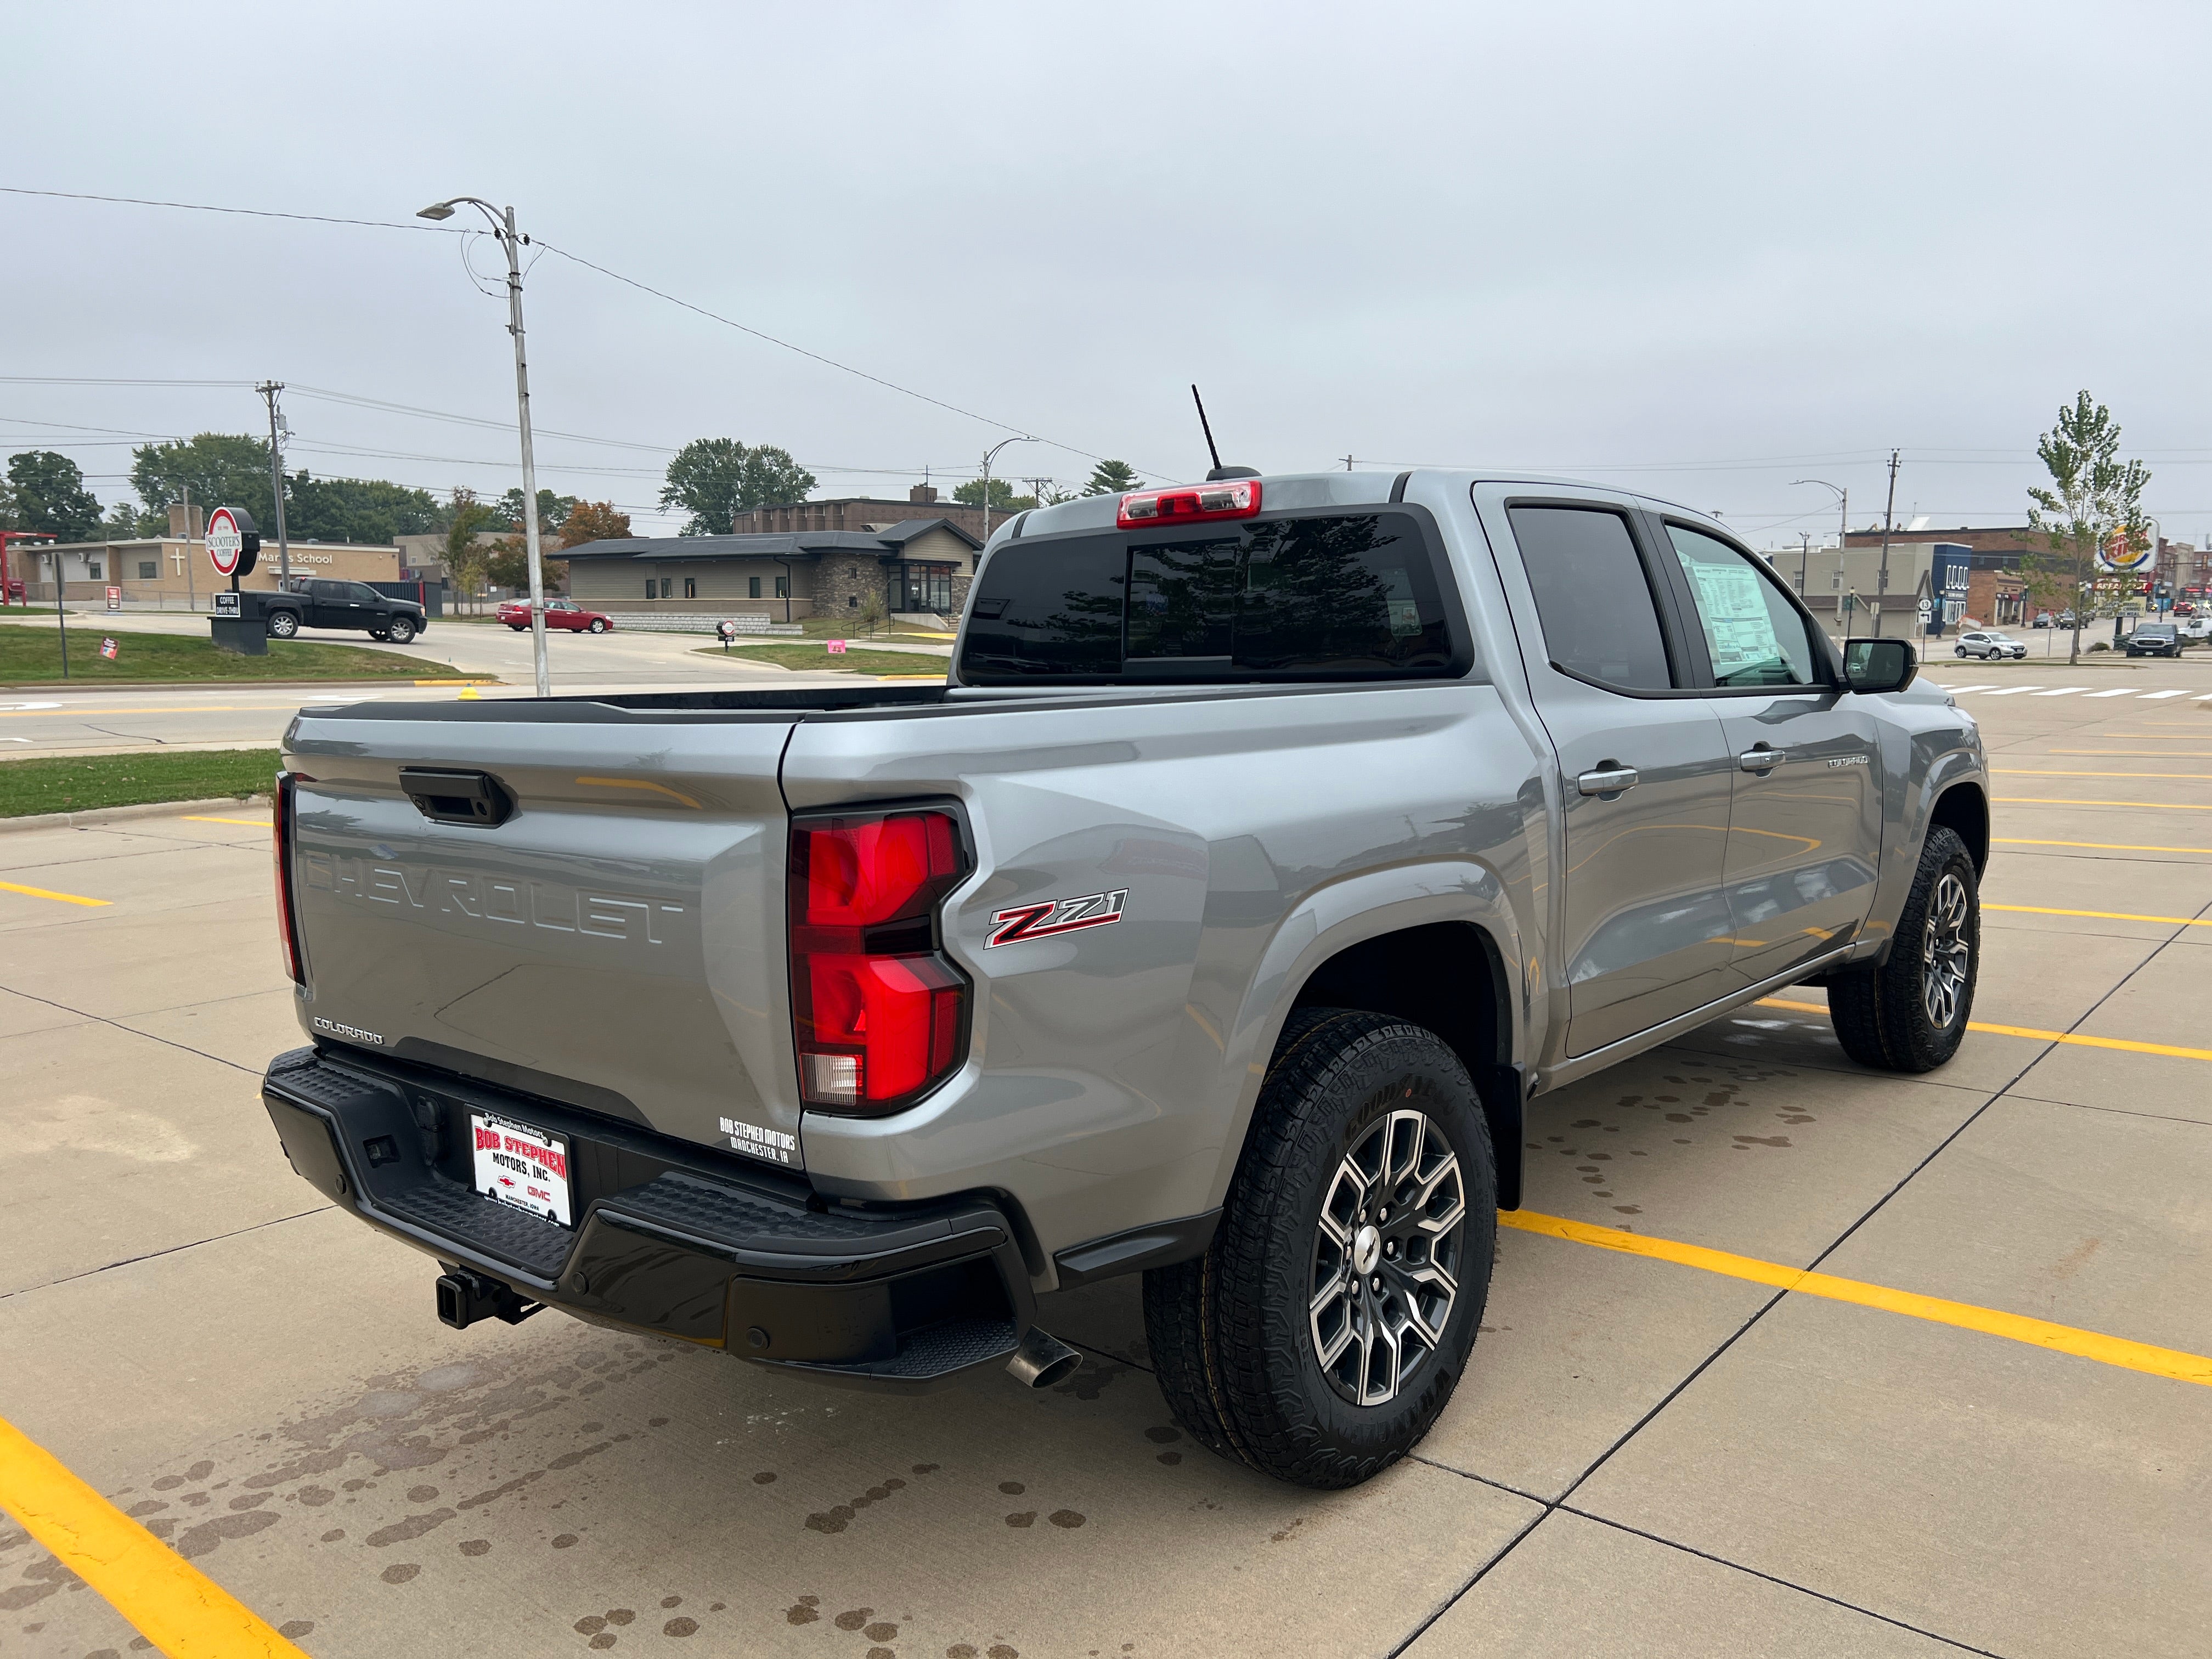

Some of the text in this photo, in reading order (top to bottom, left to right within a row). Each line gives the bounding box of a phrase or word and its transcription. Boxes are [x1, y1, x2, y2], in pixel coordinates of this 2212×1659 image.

[258, 552, 332, 564] Mars School
[217, 606, 239, 614] DRIVE-THRU
[304, 850, 684, 943] CHEVROLET
[983, 888, 1129, 950] Z71
[314, 1016, 384, 1045] COLORADO
[484, 1113, 544, 1138] Bob Stephen Motors
[720, 1116, 795, 1151] BOB STEPHEN MOTORS
[475, 1126, 567, 1182] BOB STEPHEN
[493, 1152, 551, 1182] MOTORS, INC.
[780, 1150, 789, 1164] IA
[527, 1186, 551, 1203] GMC
